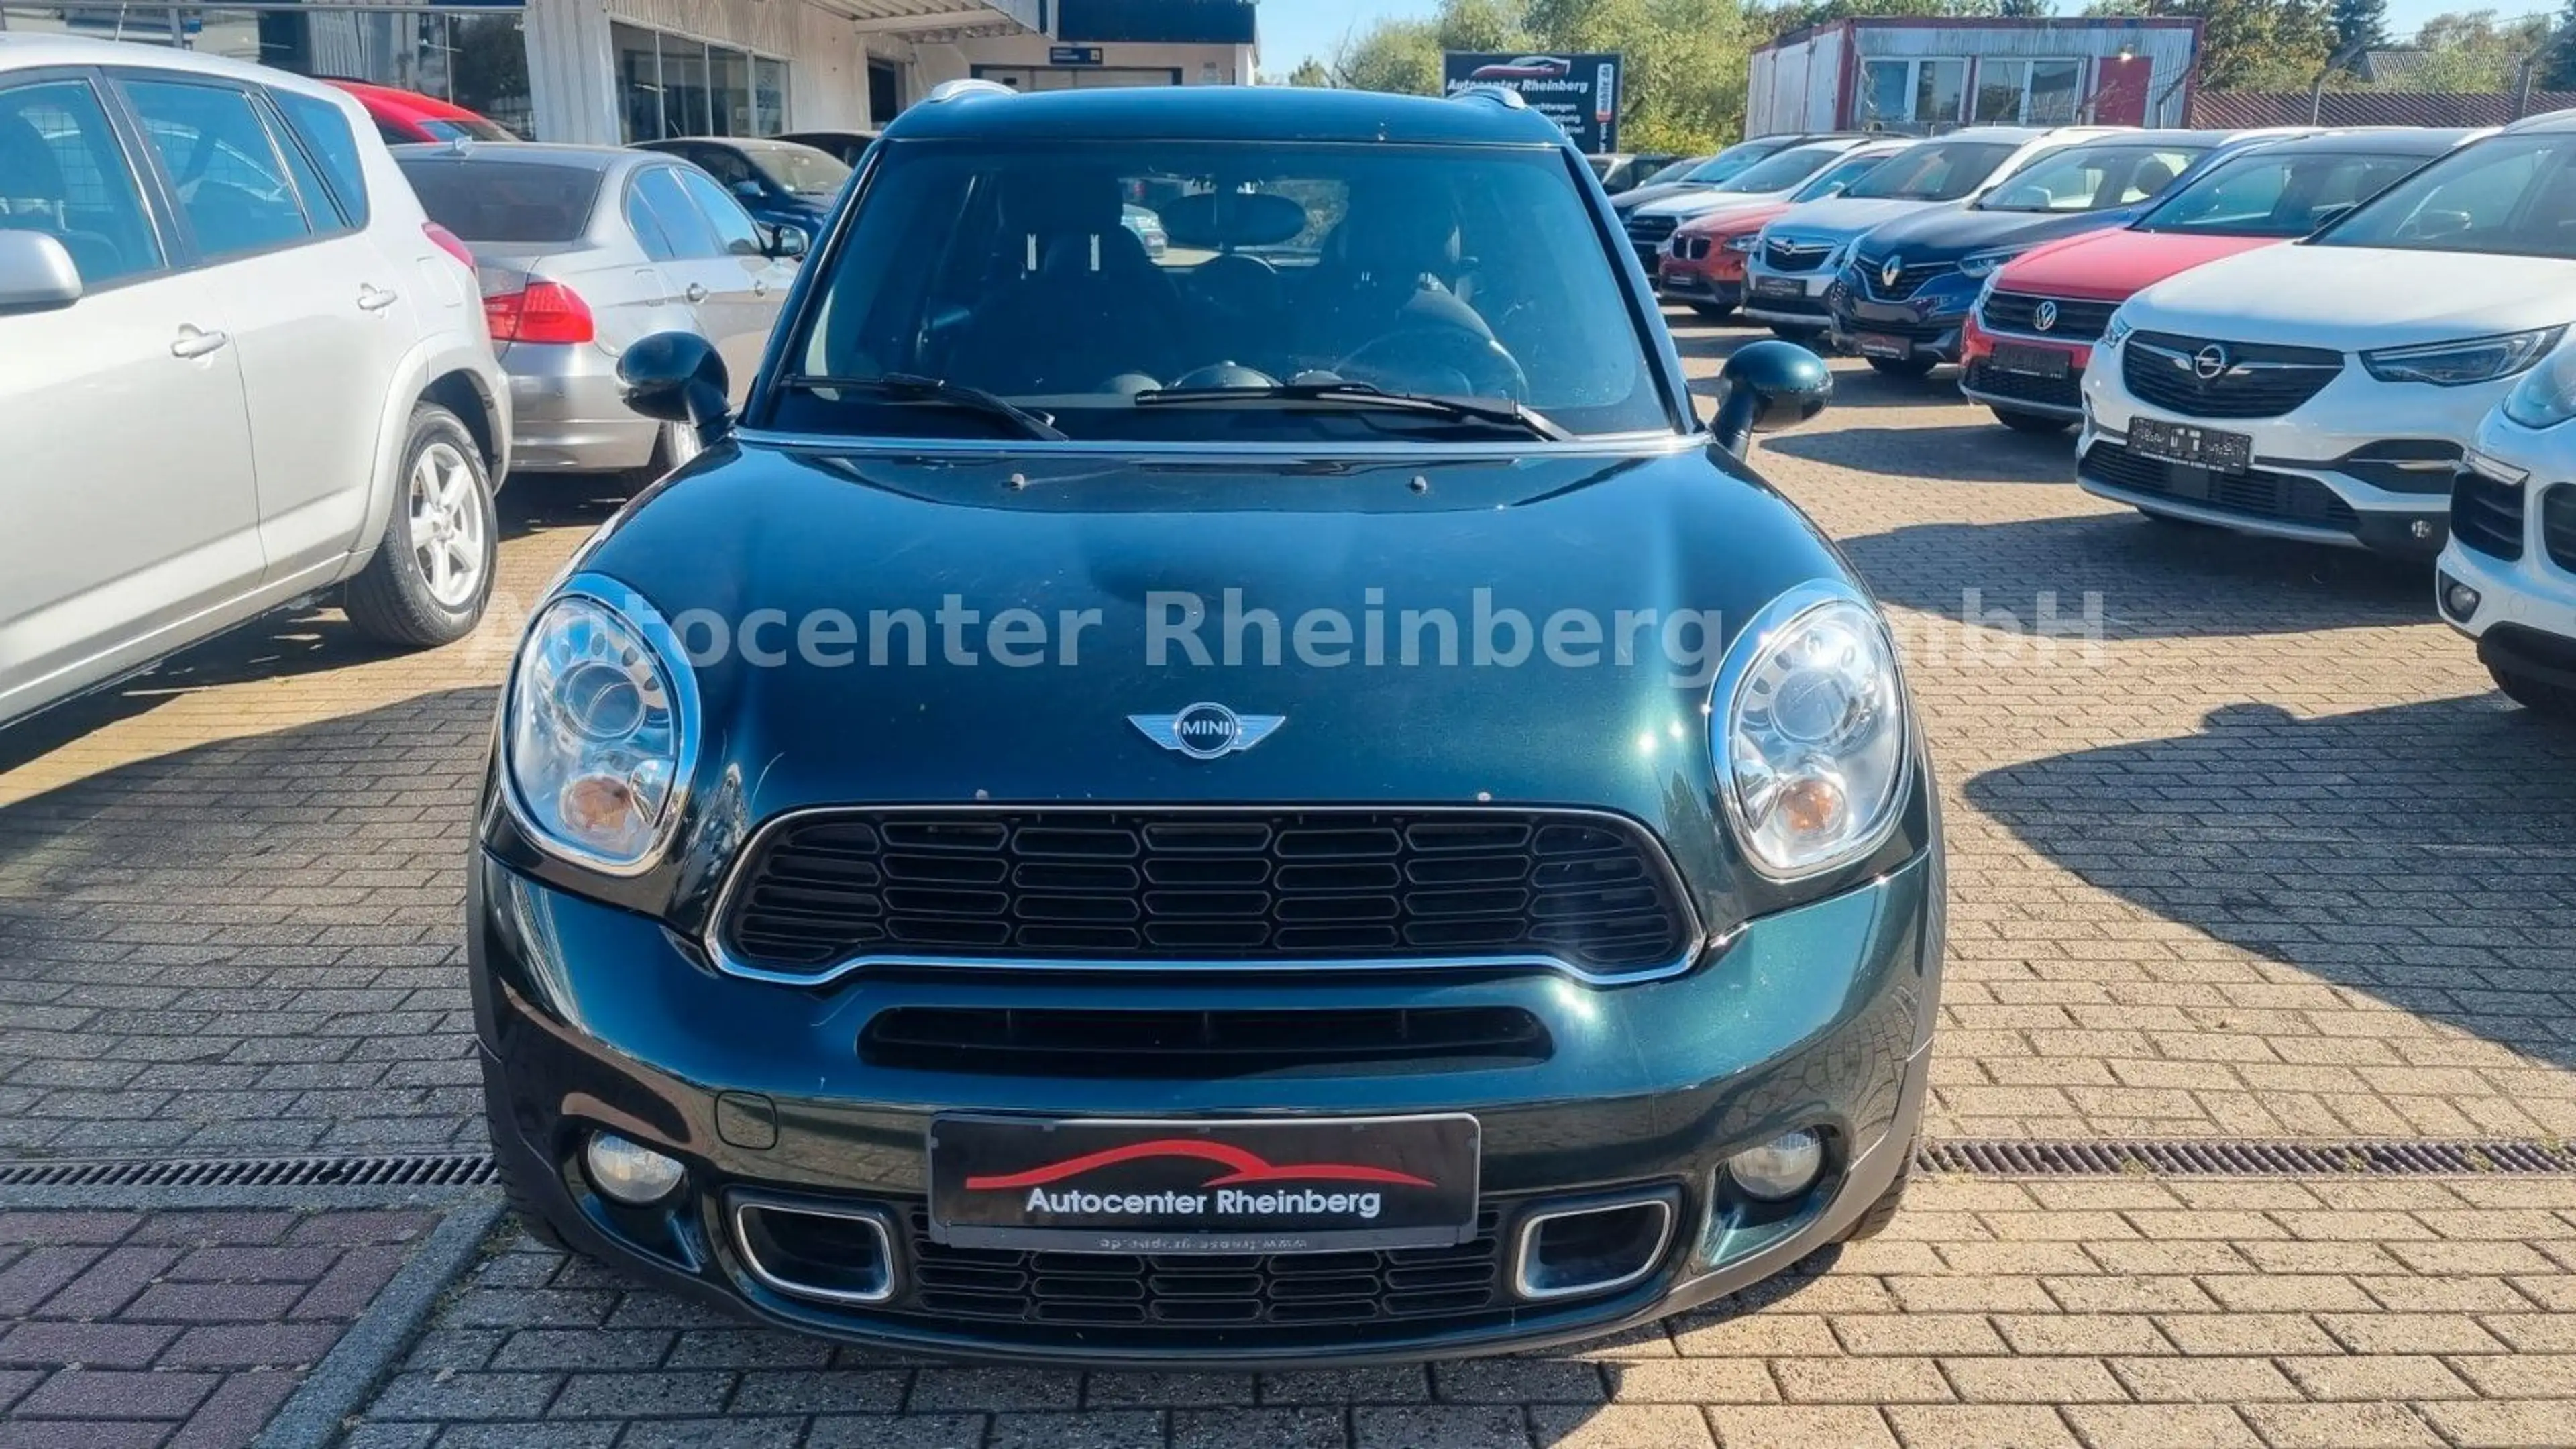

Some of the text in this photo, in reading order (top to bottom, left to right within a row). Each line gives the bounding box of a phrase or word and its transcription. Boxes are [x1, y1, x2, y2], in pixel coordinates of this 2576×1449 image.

[1521, 78, 1589, 93] Rheinberg
[1182, 720, 1230, 735] MINI
[1025, 1187, 1381, 1218] Autocenter Rheinberg
